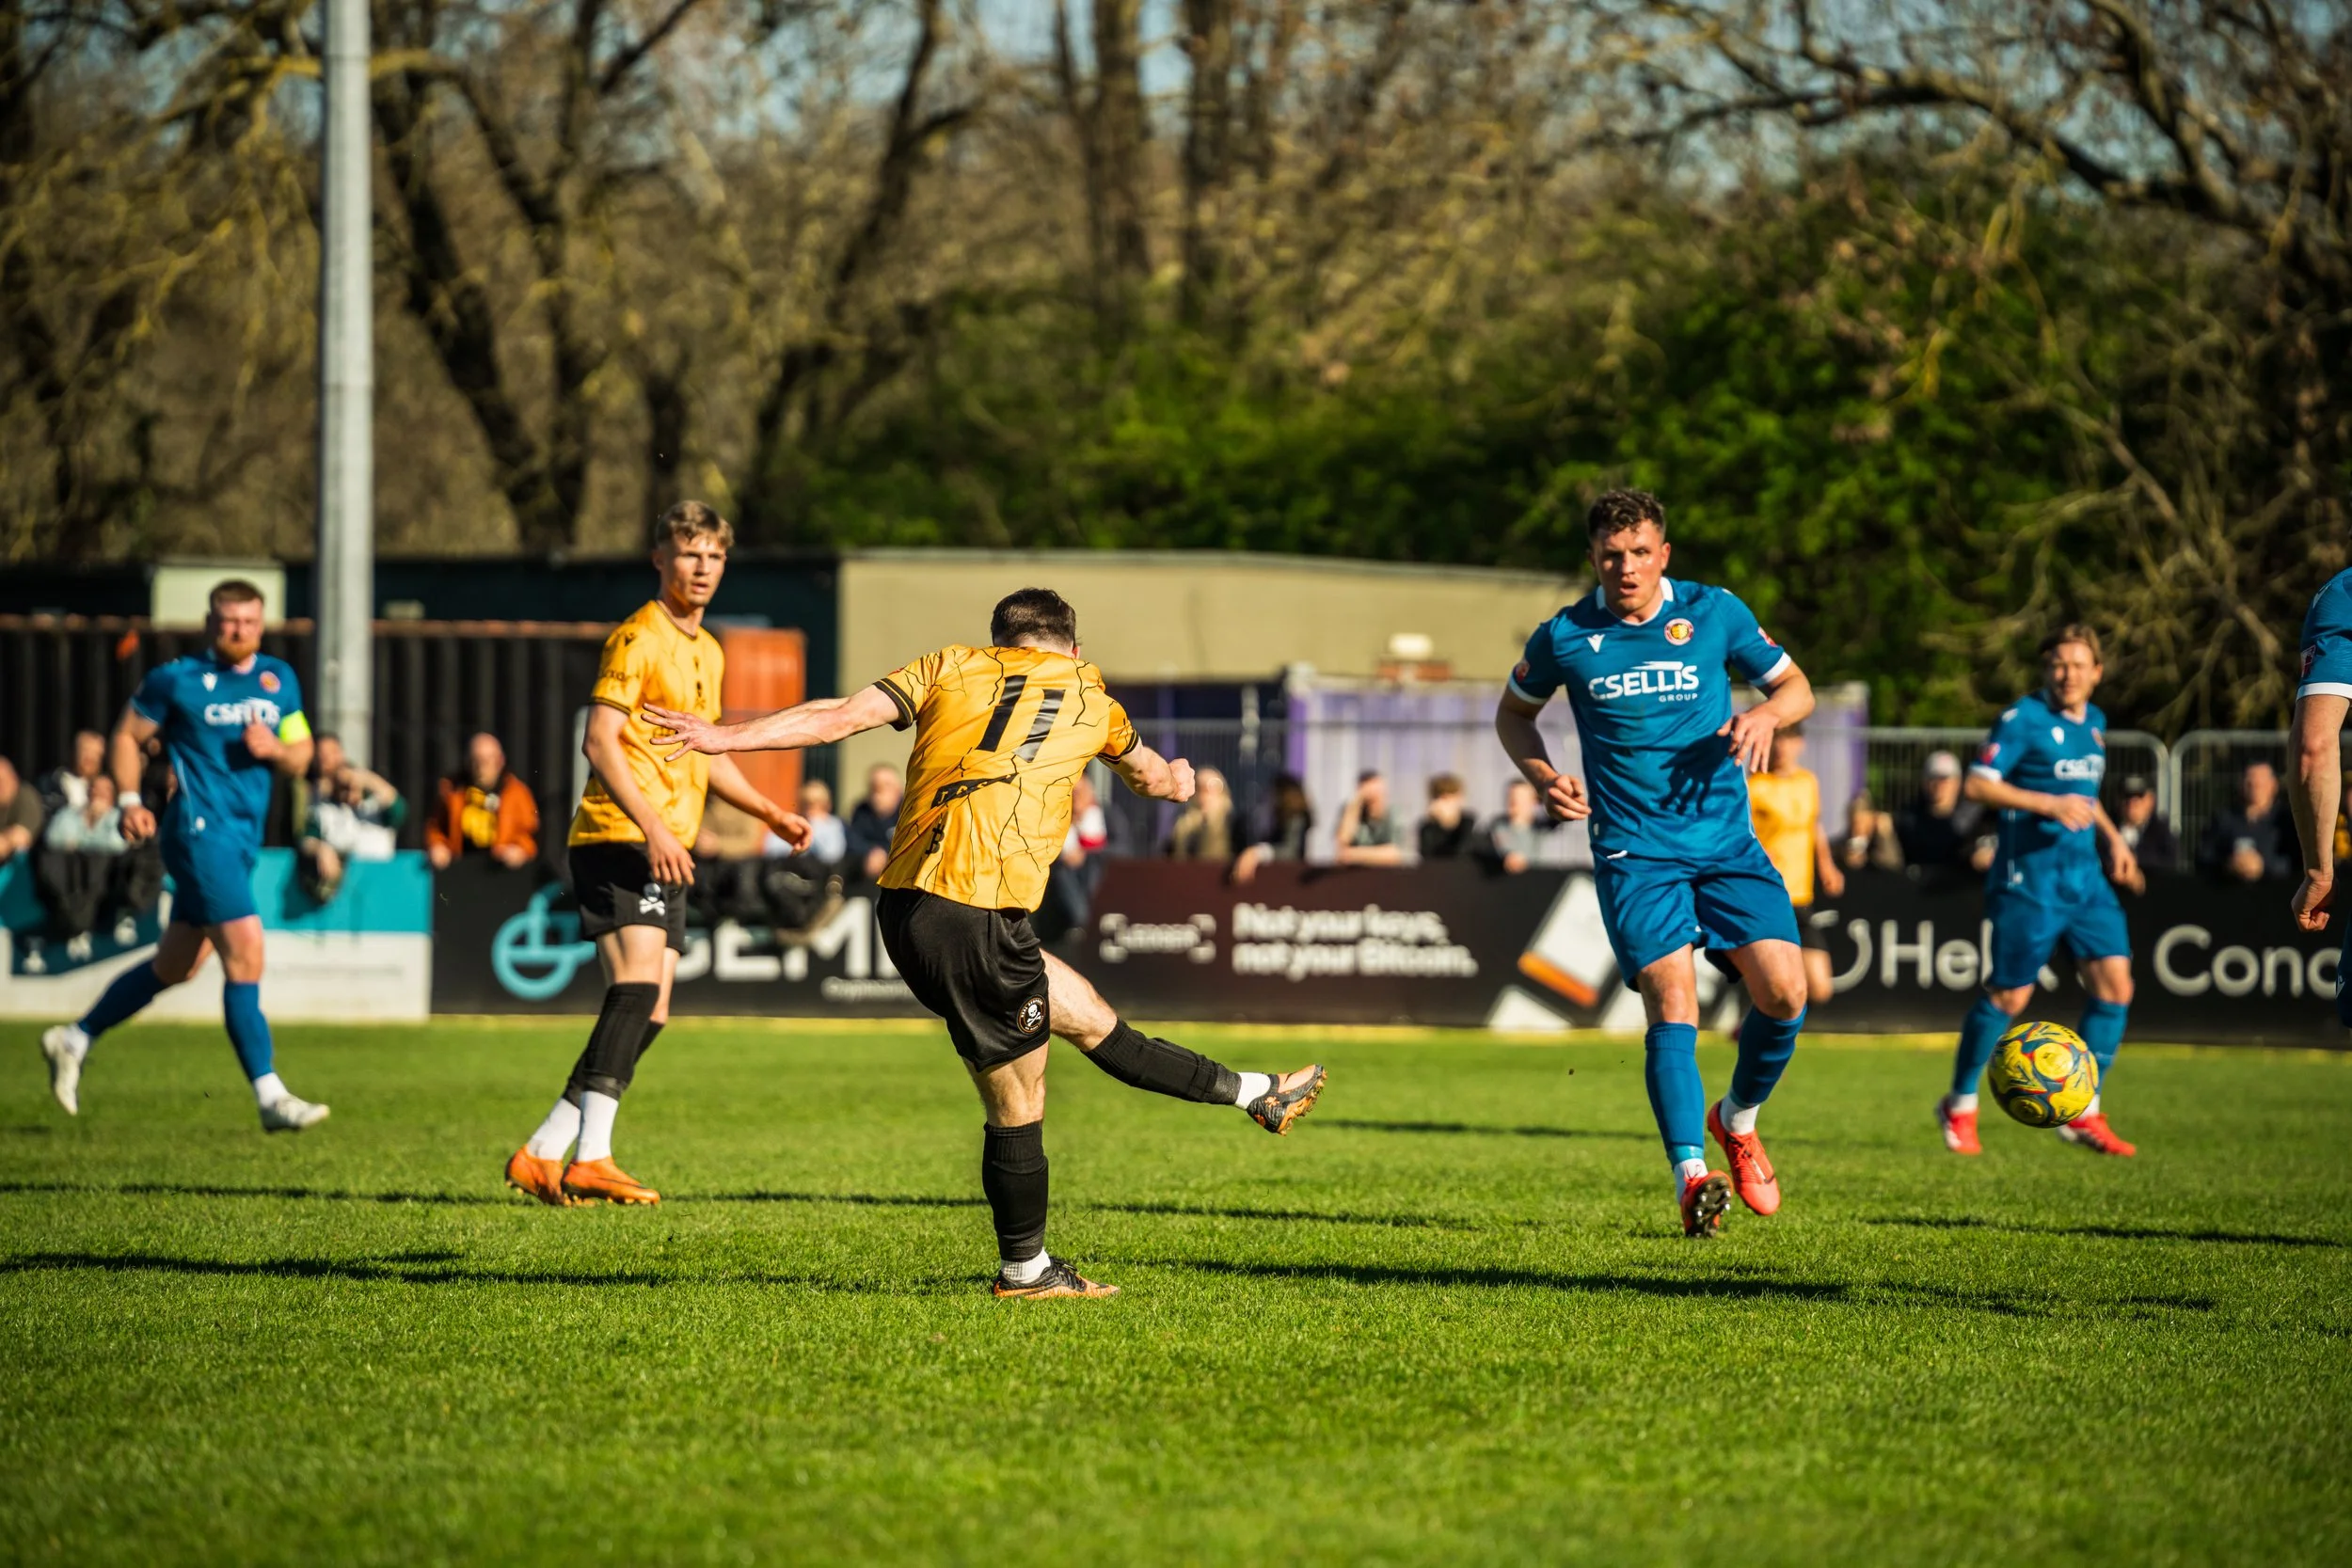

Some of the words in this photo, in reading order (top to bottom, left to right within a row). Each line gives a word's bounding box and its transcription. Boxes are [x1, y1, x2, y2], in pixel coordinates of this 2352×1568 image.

[1589, 661, 1699, 700] CSELLIS
[1659, 692, 1698, 703] GROUP
[976, 674, 1066, 763] 11
